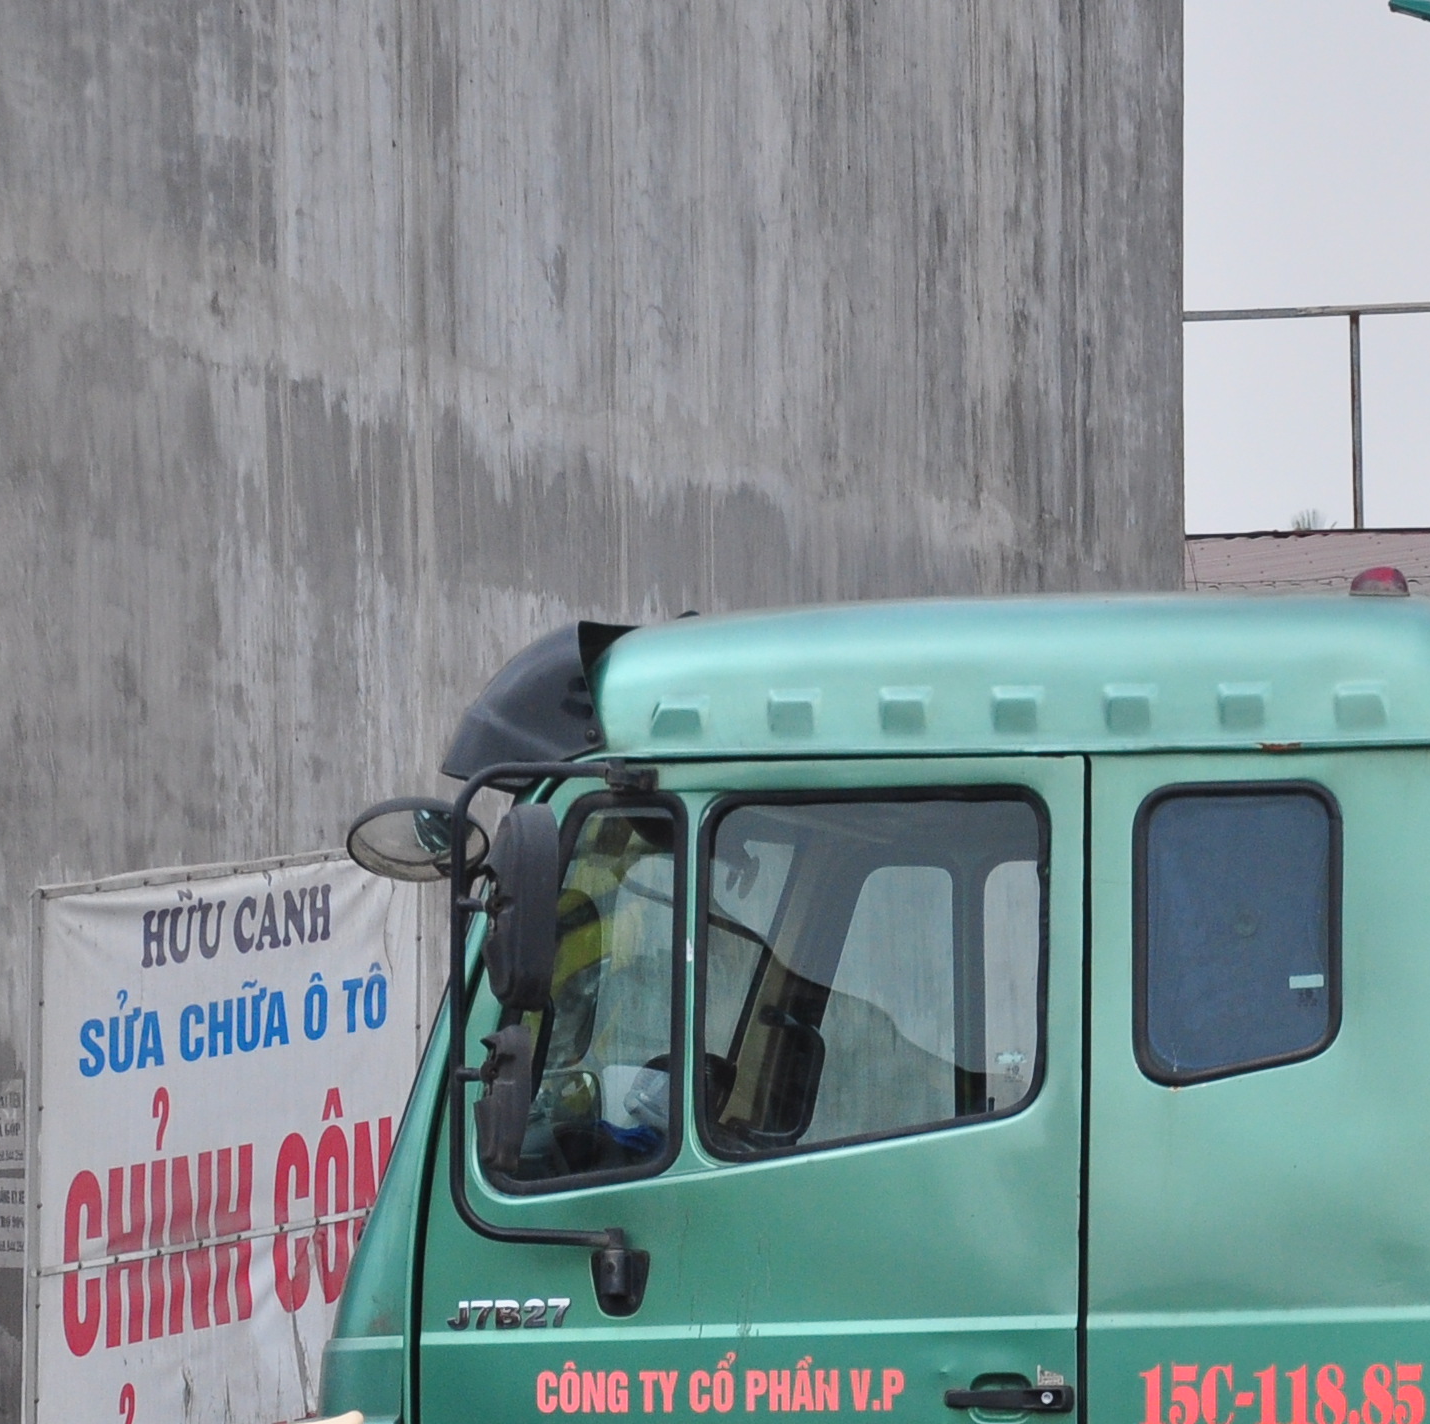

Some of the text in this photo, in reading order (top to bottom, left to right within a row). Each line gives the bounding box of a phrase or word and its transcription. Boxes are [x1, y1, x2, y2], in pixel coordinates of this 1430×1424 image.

[141, 873, 331, 969] HỮU CẢNH
[78, 962, 388, 1077] SỬA CHỮA Ô TÔ
[63, 1086, 254, 1357] CHỈNH
[447, 1298, 571, 1331] J7B27
[536, 1361, 629, 1414] CÔNG
[640, 1370, 679, 1414] TY
[688, 1351, 737, 1414] CỔ
[850, 1369, 905, 1412] V.P
